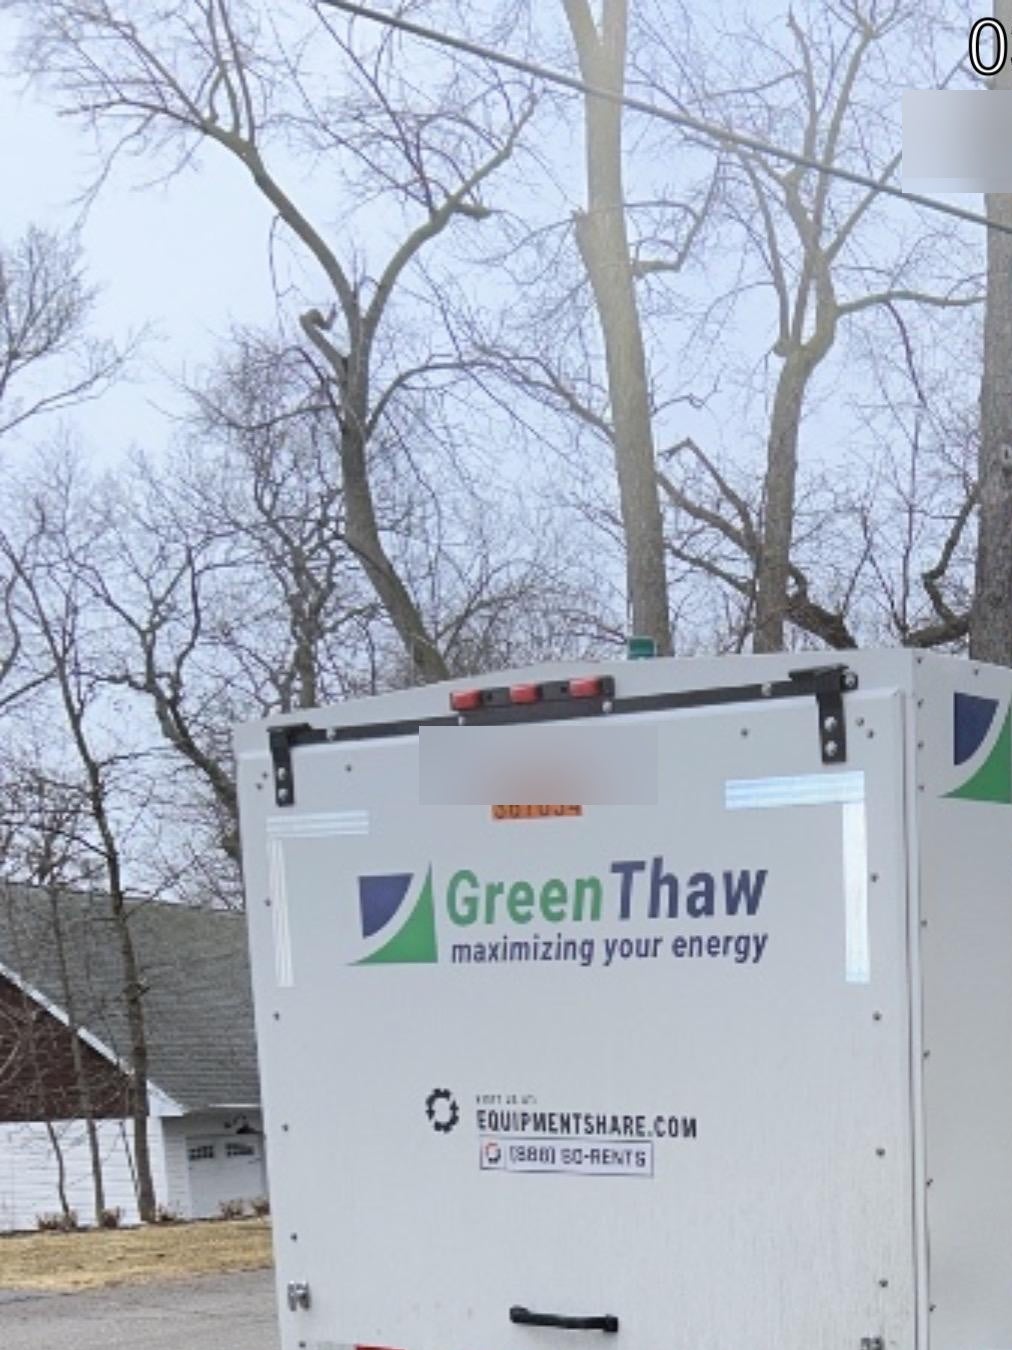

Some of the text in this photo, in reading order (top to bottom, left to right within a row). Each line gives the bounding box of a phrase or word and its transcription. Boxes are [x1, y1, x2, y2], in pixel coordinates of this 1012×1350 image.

[446, 856, 768, 926] GreenThaw
[452, 932, 768, 967] maximizing your energy
[476, 1110, 697, 1139] EQUIPMENTSHARE.COM
